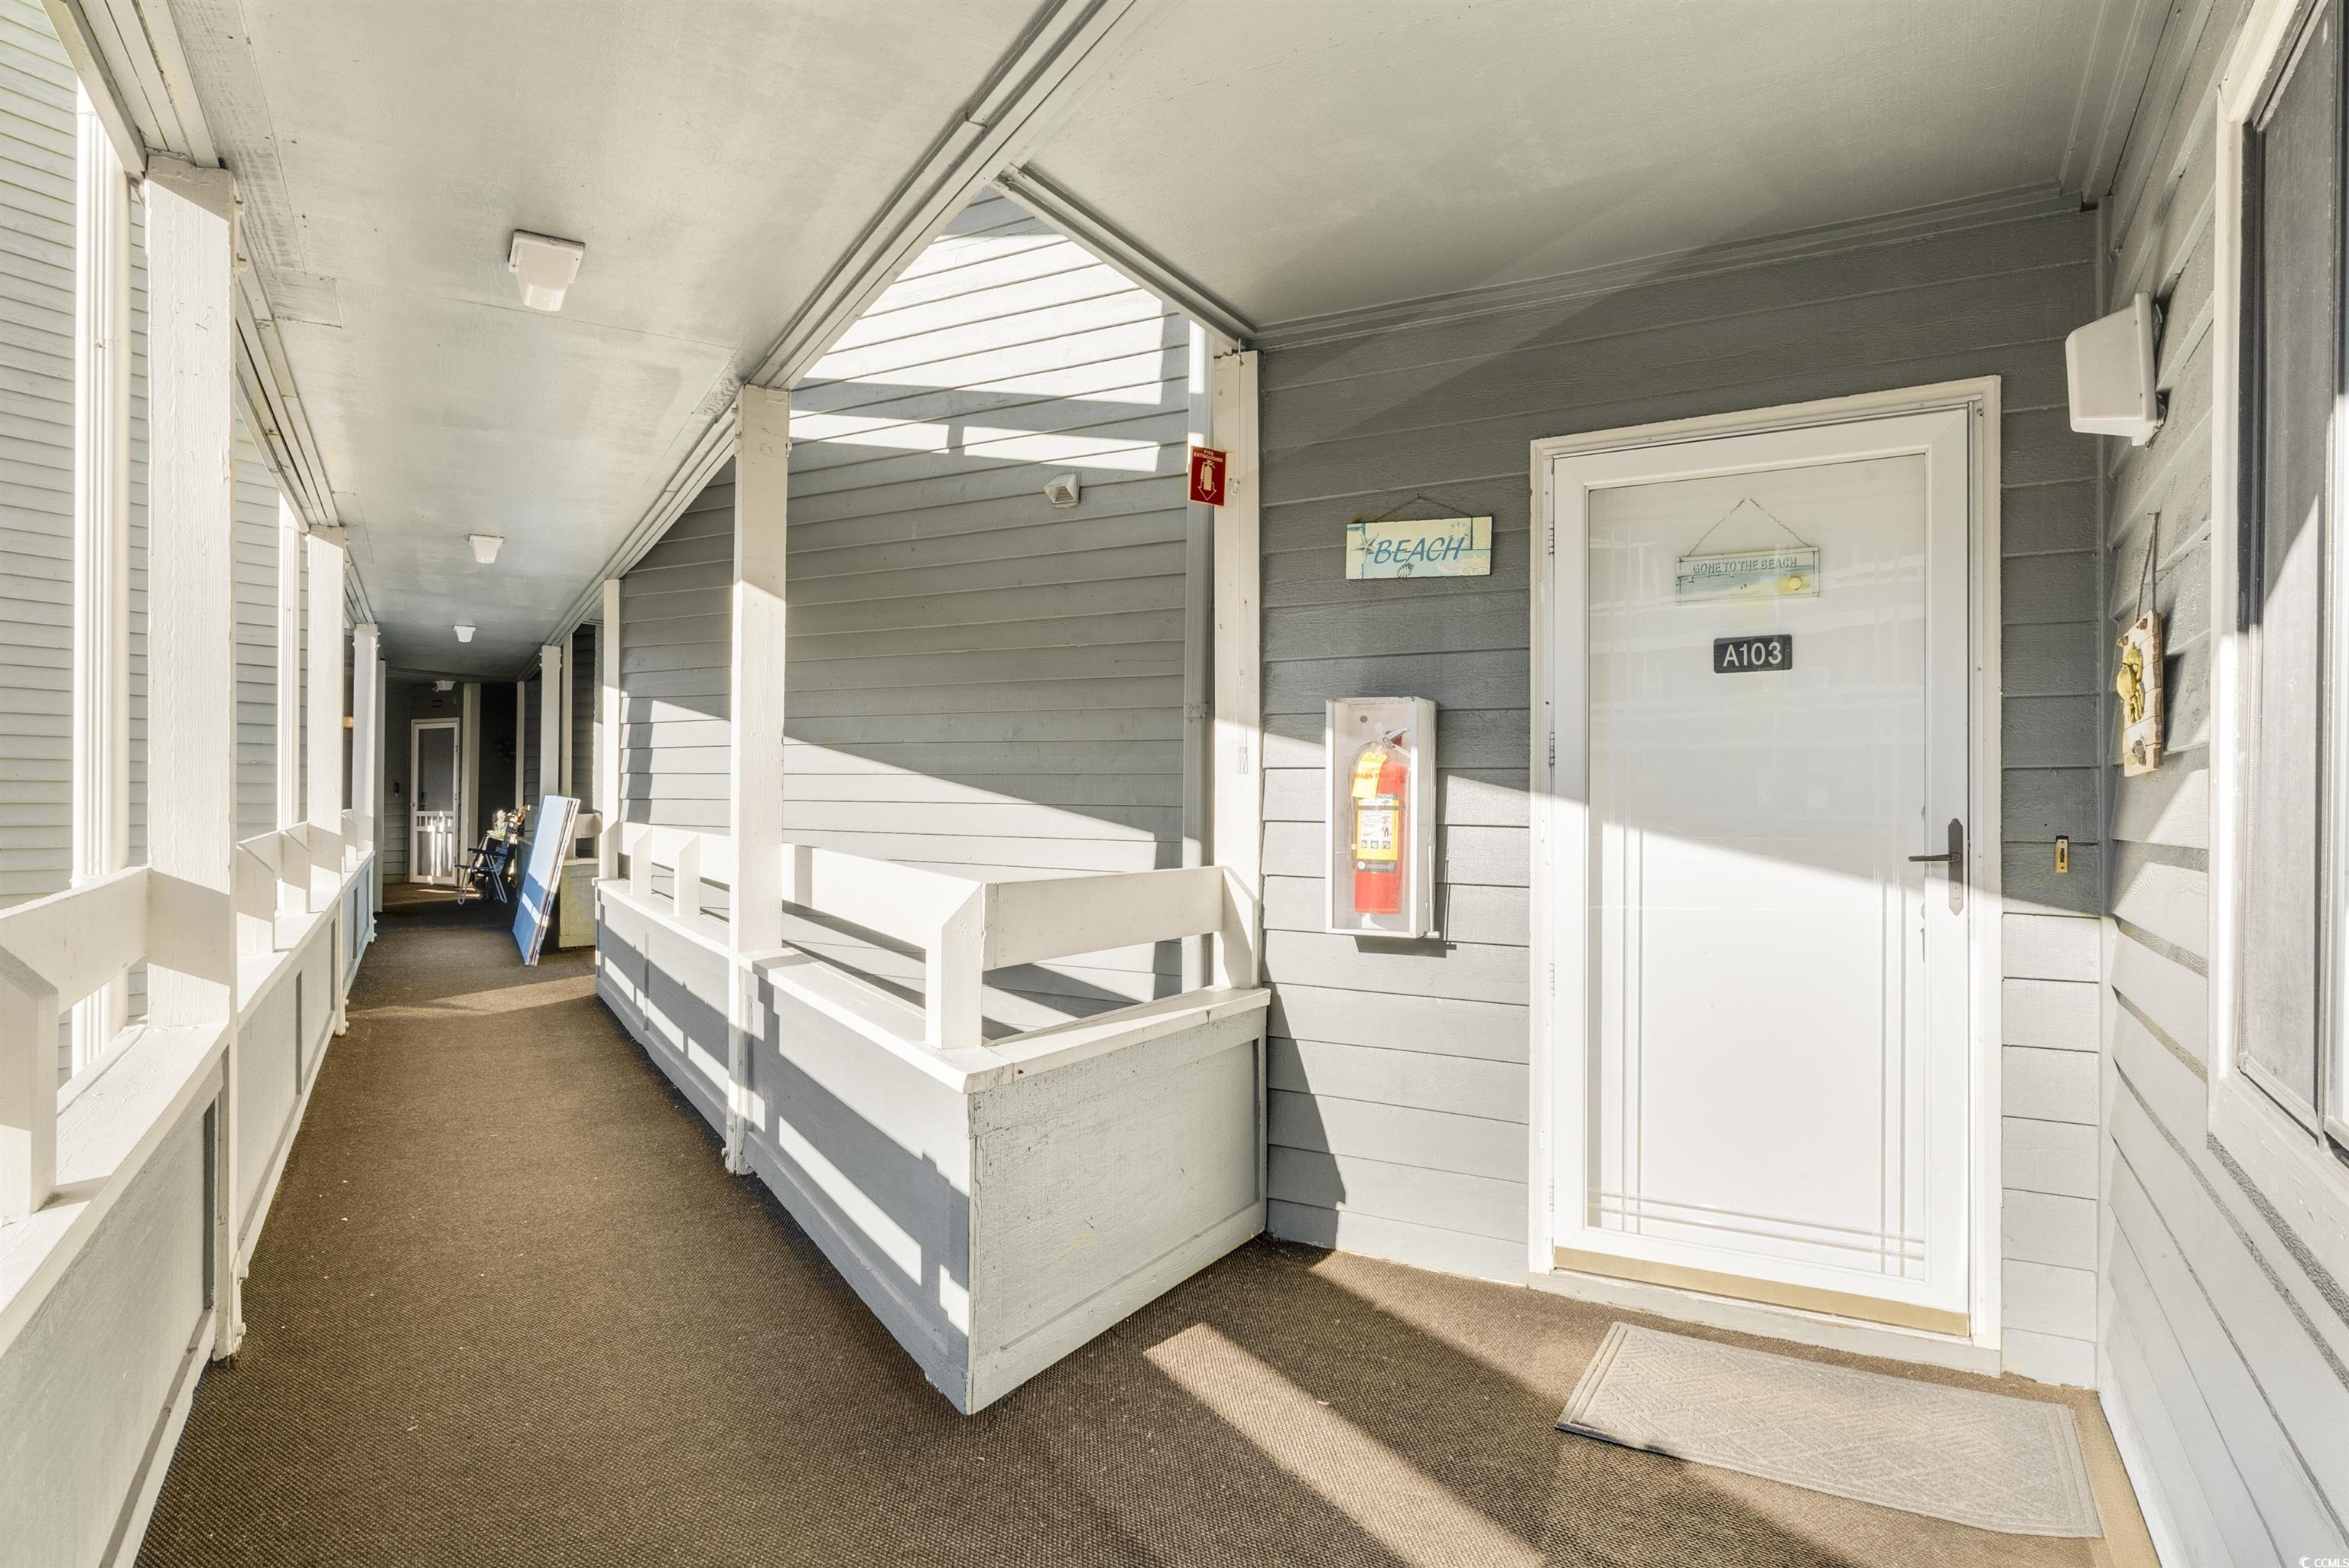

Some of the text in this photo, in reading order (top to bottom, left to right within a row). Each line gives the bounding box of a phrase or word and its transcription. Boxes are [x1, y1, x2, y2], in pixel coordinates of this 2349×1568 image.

[1194, 452, 1223, 463] EXTINGUISHER
[1373, 536, 1467, 564] BEACH
[1693, 557, 1798, 574] GONE TO THE BEACH
[1722, 641, 1782, 667] A103
